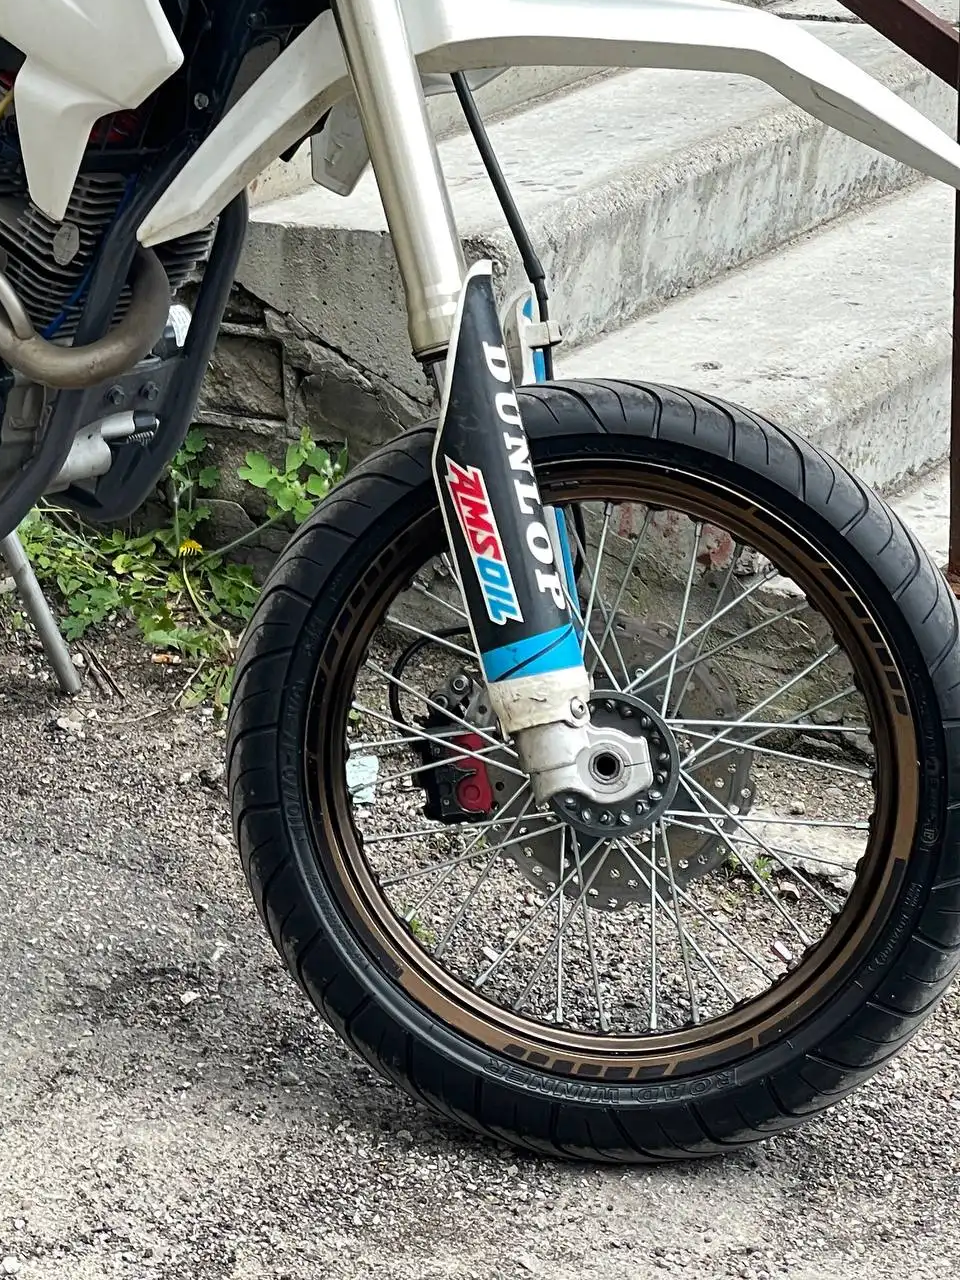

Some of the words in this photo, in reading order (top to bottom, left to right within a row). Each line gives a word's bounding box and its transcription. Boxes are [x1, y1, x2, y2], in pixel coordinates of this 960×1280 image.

[482, 341, 567, 610] DUNLOP
[444, 454, 524, 626] AMSOIL
[482, 1057, 620, 1105] WINNER
[635, 1068, 738, 1103] ROAD
